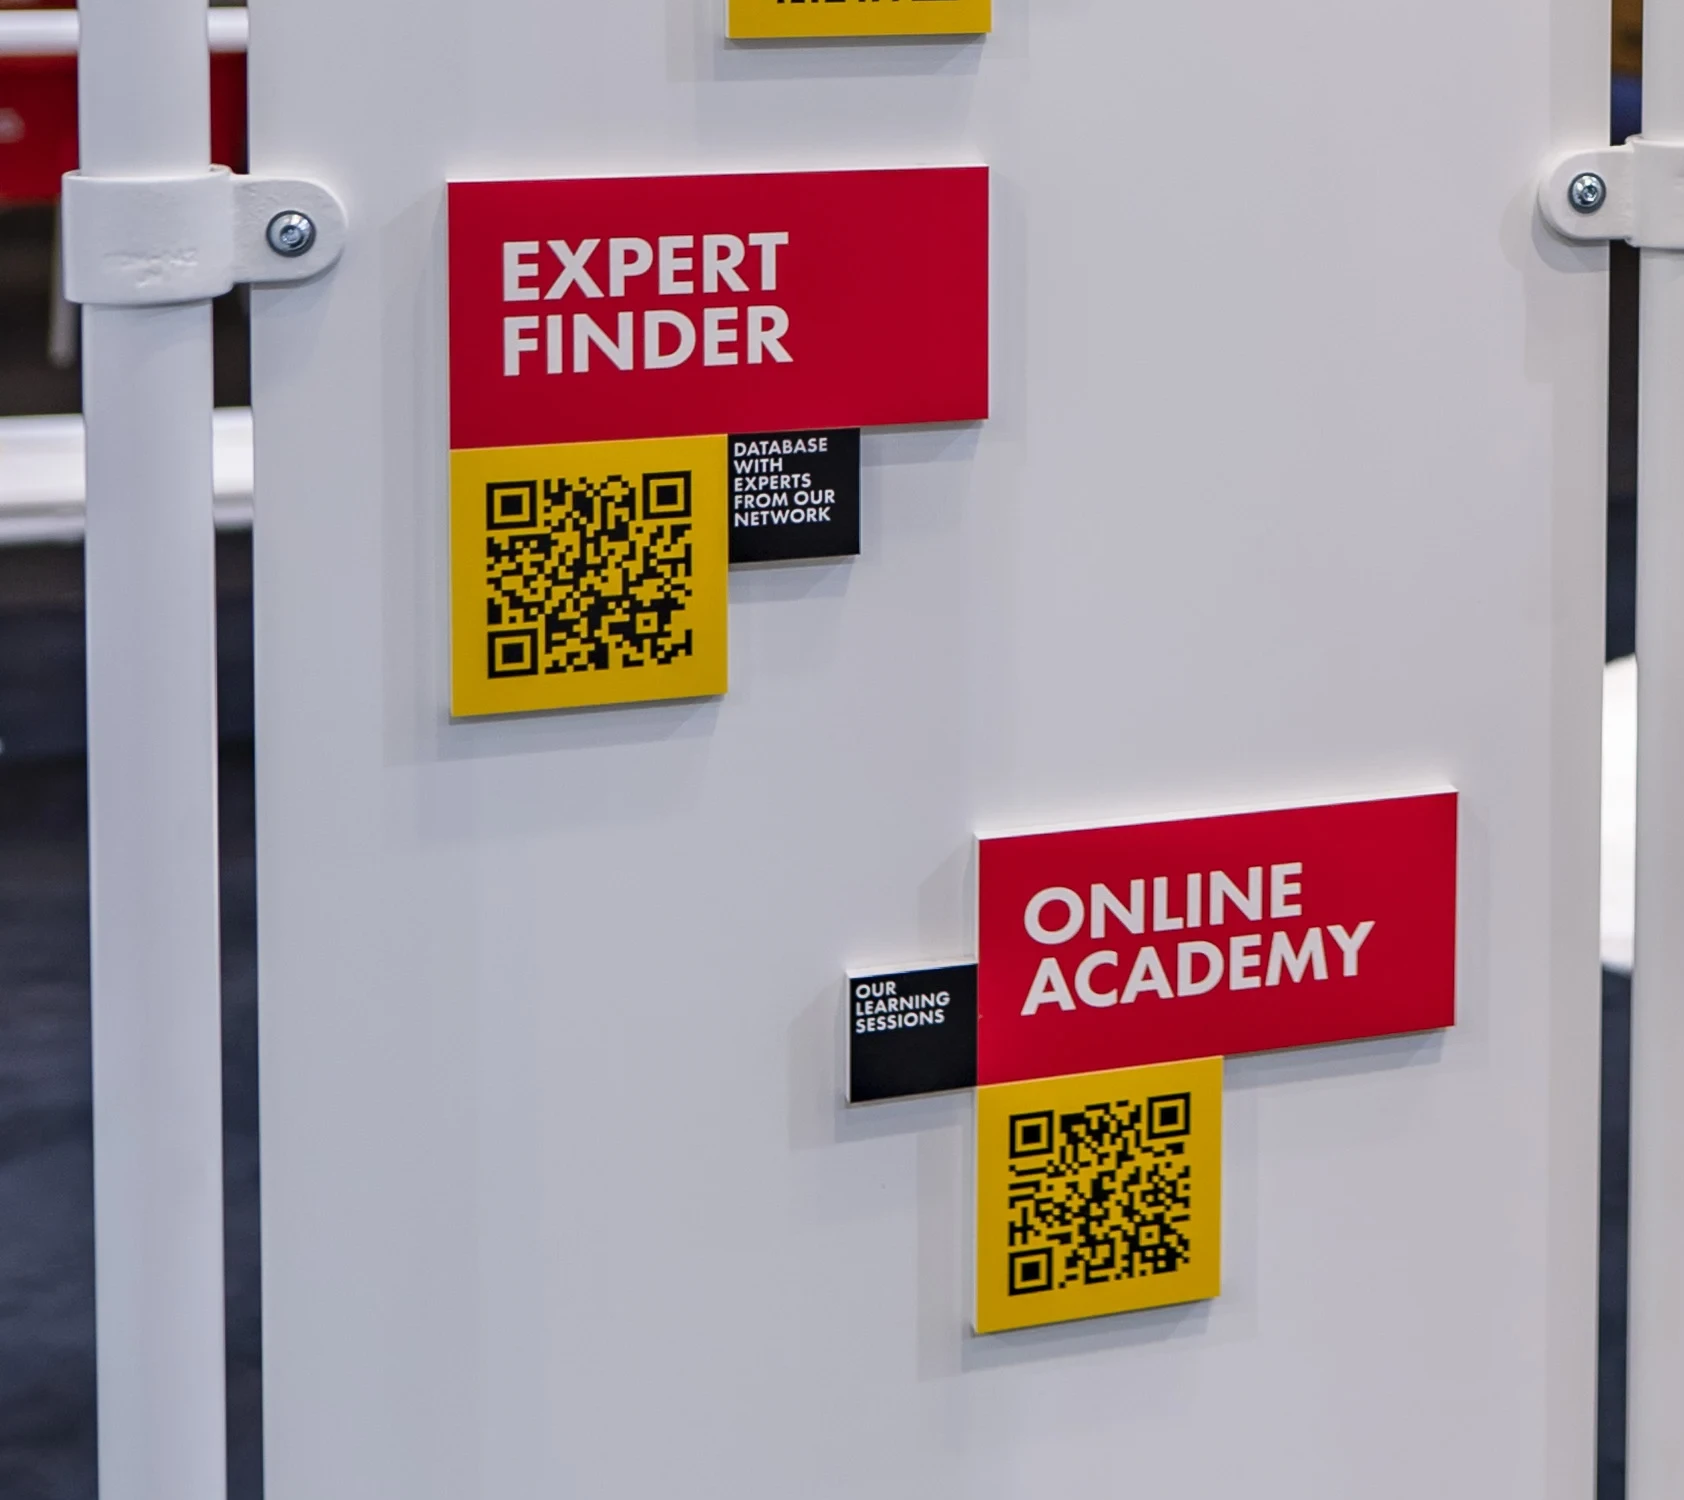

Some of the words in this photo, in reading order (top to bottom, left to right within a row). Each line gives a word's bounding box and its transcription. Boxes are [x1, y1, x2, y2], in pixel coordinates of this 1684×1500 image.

[503, 231, 789, 302] EXPERT
[503, 305, 794, 376] FINDER
[734, 437, 828, 457] DATABASE
[733, 457, 783, 475] WITH
[734, 472, 812, 493] EXPERTS
[734, 492, 789, 510] FROM
[793, 488, 836, 506] OUR
[734, 506, 831, 528] NETWORK
[1024, 862, 1302, 945] ONLINE
[1020, 920, 1375, 1016] ACADEMY
[855, 980, 897, 999] OUR
[855, 990, 951, 1017] LEARNING
[855, 1008, 945, 1034] SESSIONS
